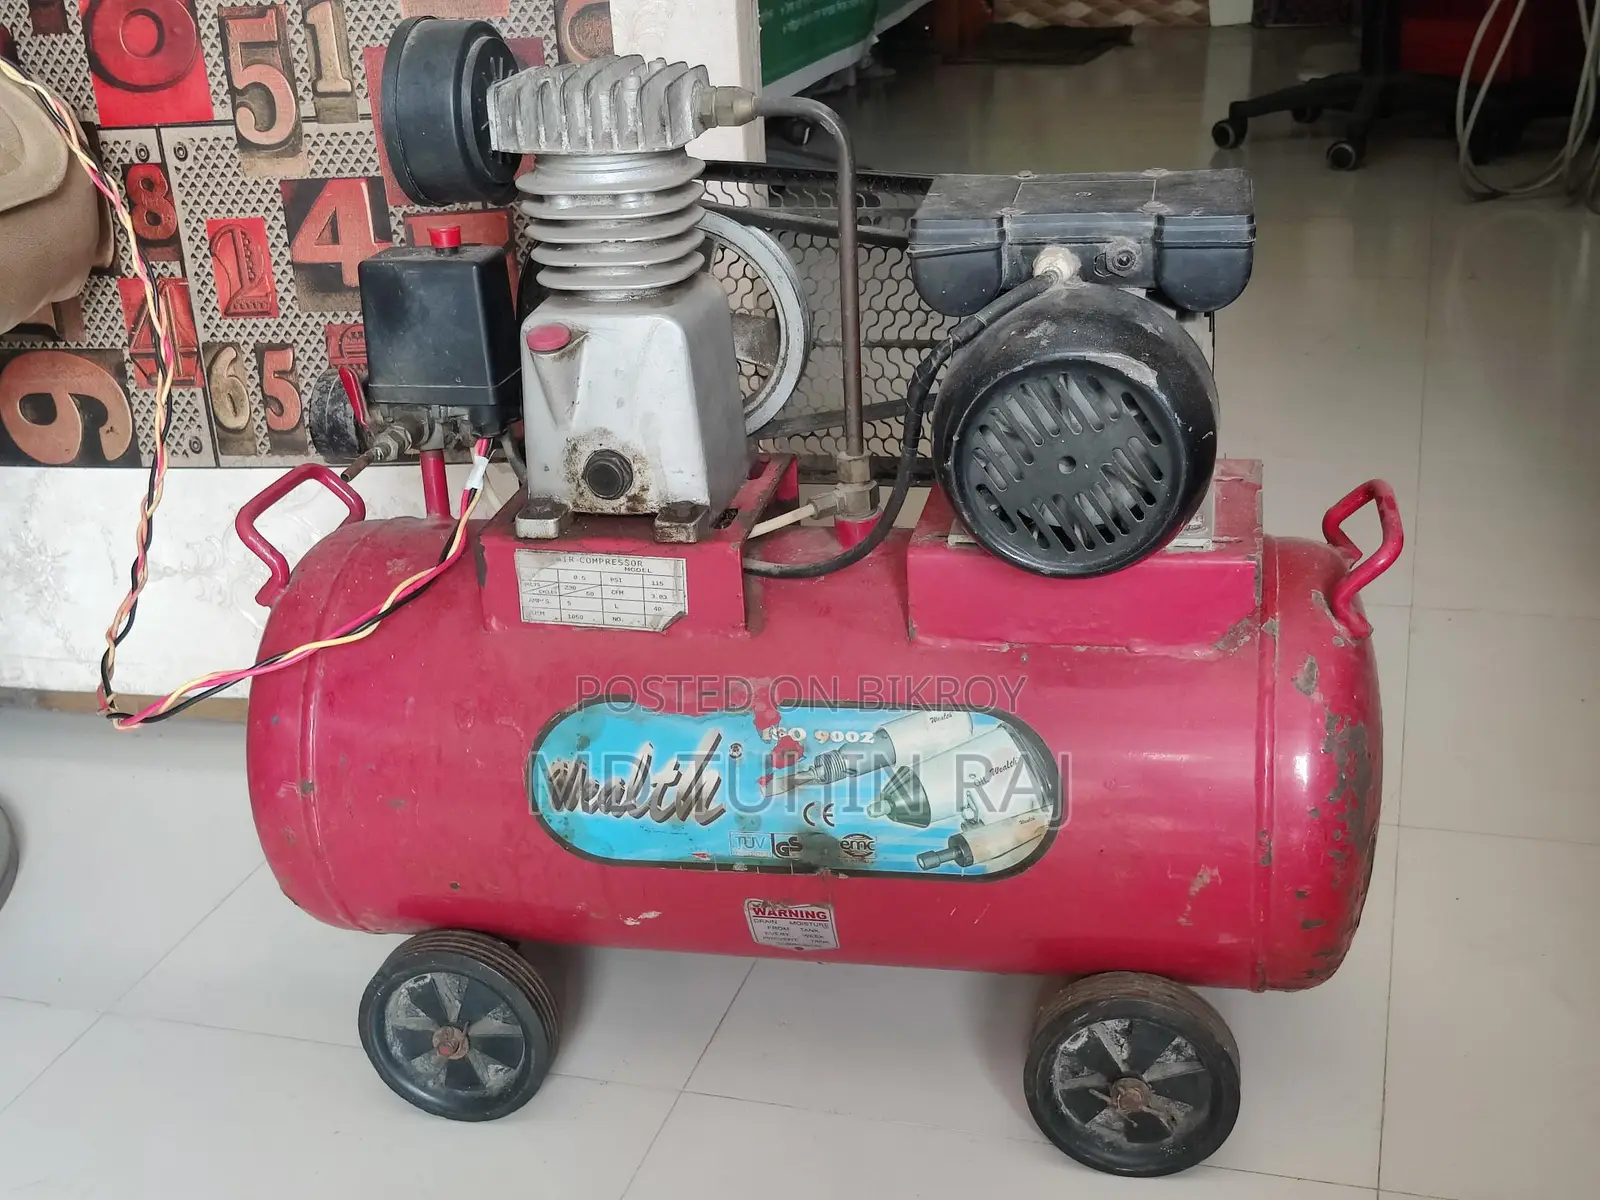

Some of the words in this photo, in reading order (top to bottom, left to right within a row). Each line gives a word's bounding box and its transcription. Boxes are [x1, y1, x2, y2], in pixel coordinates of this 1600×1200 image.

[126, 164, 178, 240] 8
[290, 178, 394, 288] 4
[579, 556, 644, 567] COMPRESSOR
[815, 730, 875, 743] 9002
[803, 802, 835, 828] CE
[737, 837, 765, 849] TÜV
[753, 908, 828, 920] WARNING
[789, 920, 829, 928] MOISTURE
